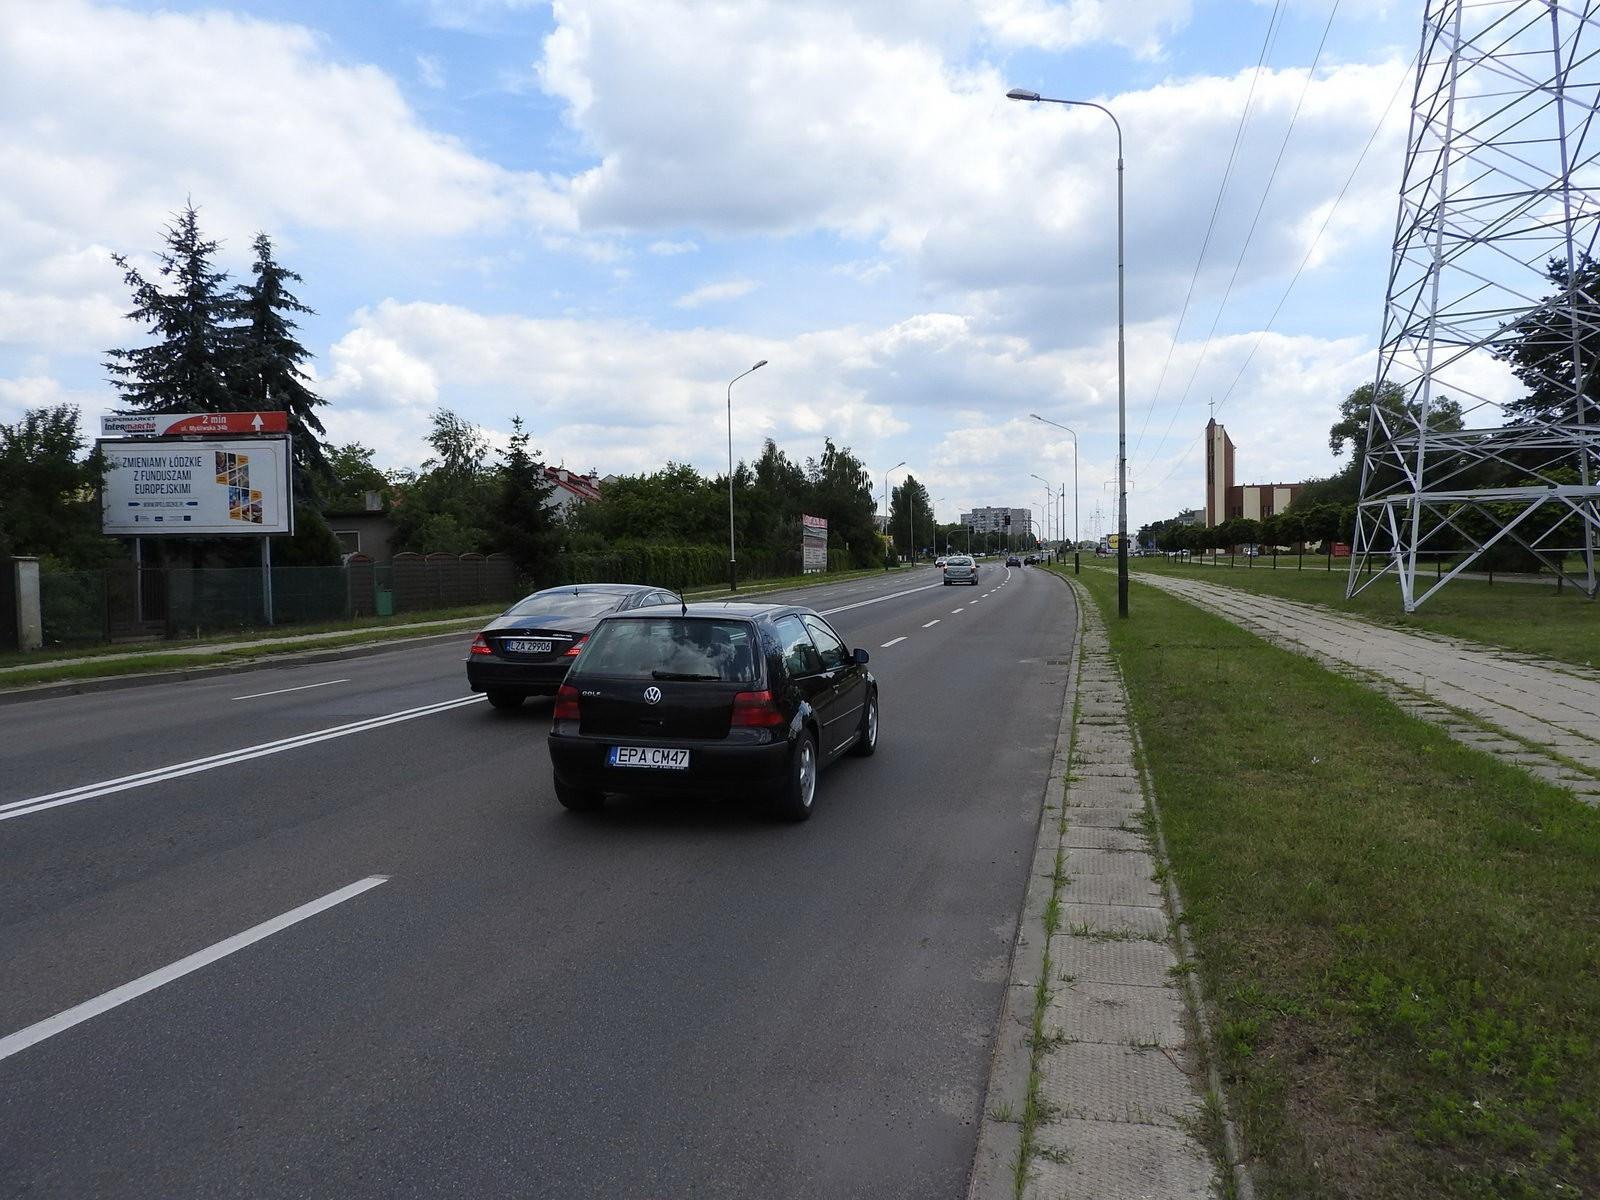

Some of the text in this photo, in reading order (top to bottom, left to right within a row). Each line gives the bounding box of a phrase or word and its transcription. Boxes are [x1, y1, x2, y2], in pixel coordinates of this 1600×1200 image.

[202, 414, 227, 424] 2 min
[122, 455, 203, 468] ZMIENIAMY ŁÓDZKIE
[133, 470, 192, 481] Z FUNDUSZAMI
[134, 483, 191, 495] EUROPEJSKIMI
[510, 641, 551, 652] LZA 29906
[618, 748, 647, 764] EPA
[651, 749, 687, 766] CM47
